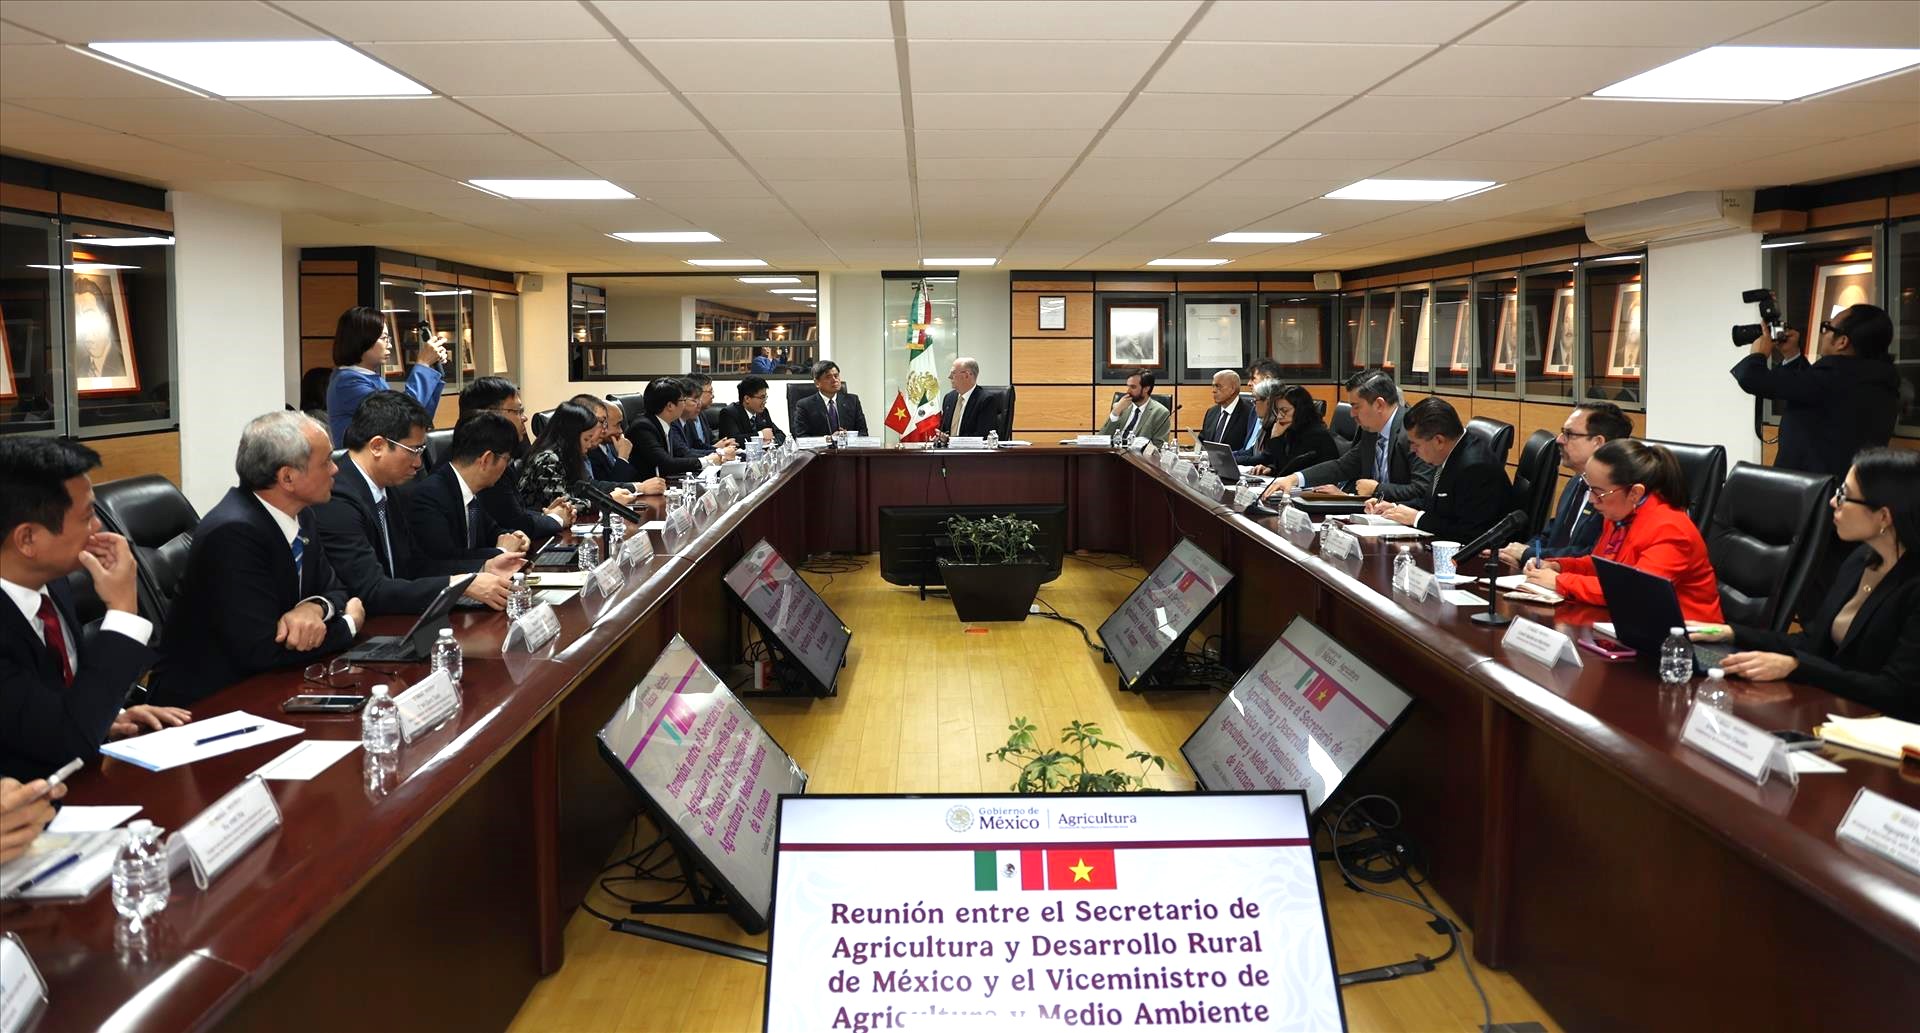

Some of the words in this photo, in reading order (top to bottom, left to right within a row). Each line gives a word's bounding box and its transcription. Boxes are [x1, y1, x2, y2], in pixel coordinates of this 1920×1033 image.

[979, 807, 1026, 816] Gobierno
[1028, 807, 1040, 816] de
[979, 815, 1040, 830] México
[1058, 812, 1137, 826] Agricultura
[830, 900, 944, 925] Reunión
[955, 903, 1030, 924] entre
[1040, 900, 1065, 923] el
[1075, 898, 1219, 923] Secretario
[1229, 896, 1260, 920] de
[831, 935, 994, 966] Agricultura
[1004, 941, 1021, 964] y
[1031, 931, 1177, 957] Desarrollo
[1187, 929, 1263, 954] Rural
[828, 969, 860, 994] de
[872, 968, 972, 993] México
[983, 975, 1000, 998] y
[1011, 968, 1035, 992] el
[1045, 966, 1227, 991] Viceministro
[1237, 963, 1270, 987] de
[1038, 1001, 1123, 1026] Medio
[1134, 999, 1270, 1026] Ambiente
